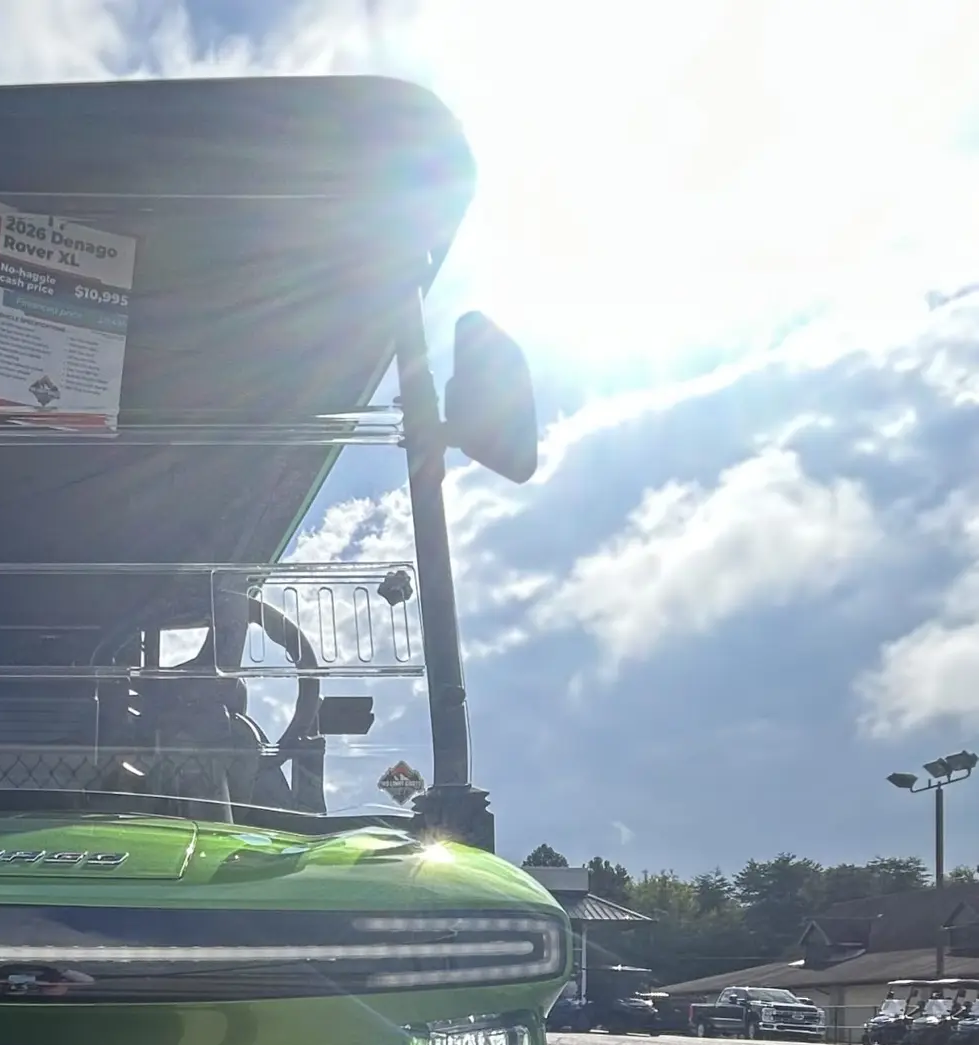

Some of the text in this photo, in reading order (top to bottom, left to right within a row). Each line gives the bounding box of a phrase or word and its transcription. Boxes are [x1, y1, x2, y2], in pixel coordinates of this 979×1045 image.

[5, 215, 118, 259] 2026 Denago
[3, 235, 80, 267] Rover XL
[0, 262, 56, 285] No-haggle
[0, 274, 54, 296] cash price
[74, 285, 128, 306] $10,995
